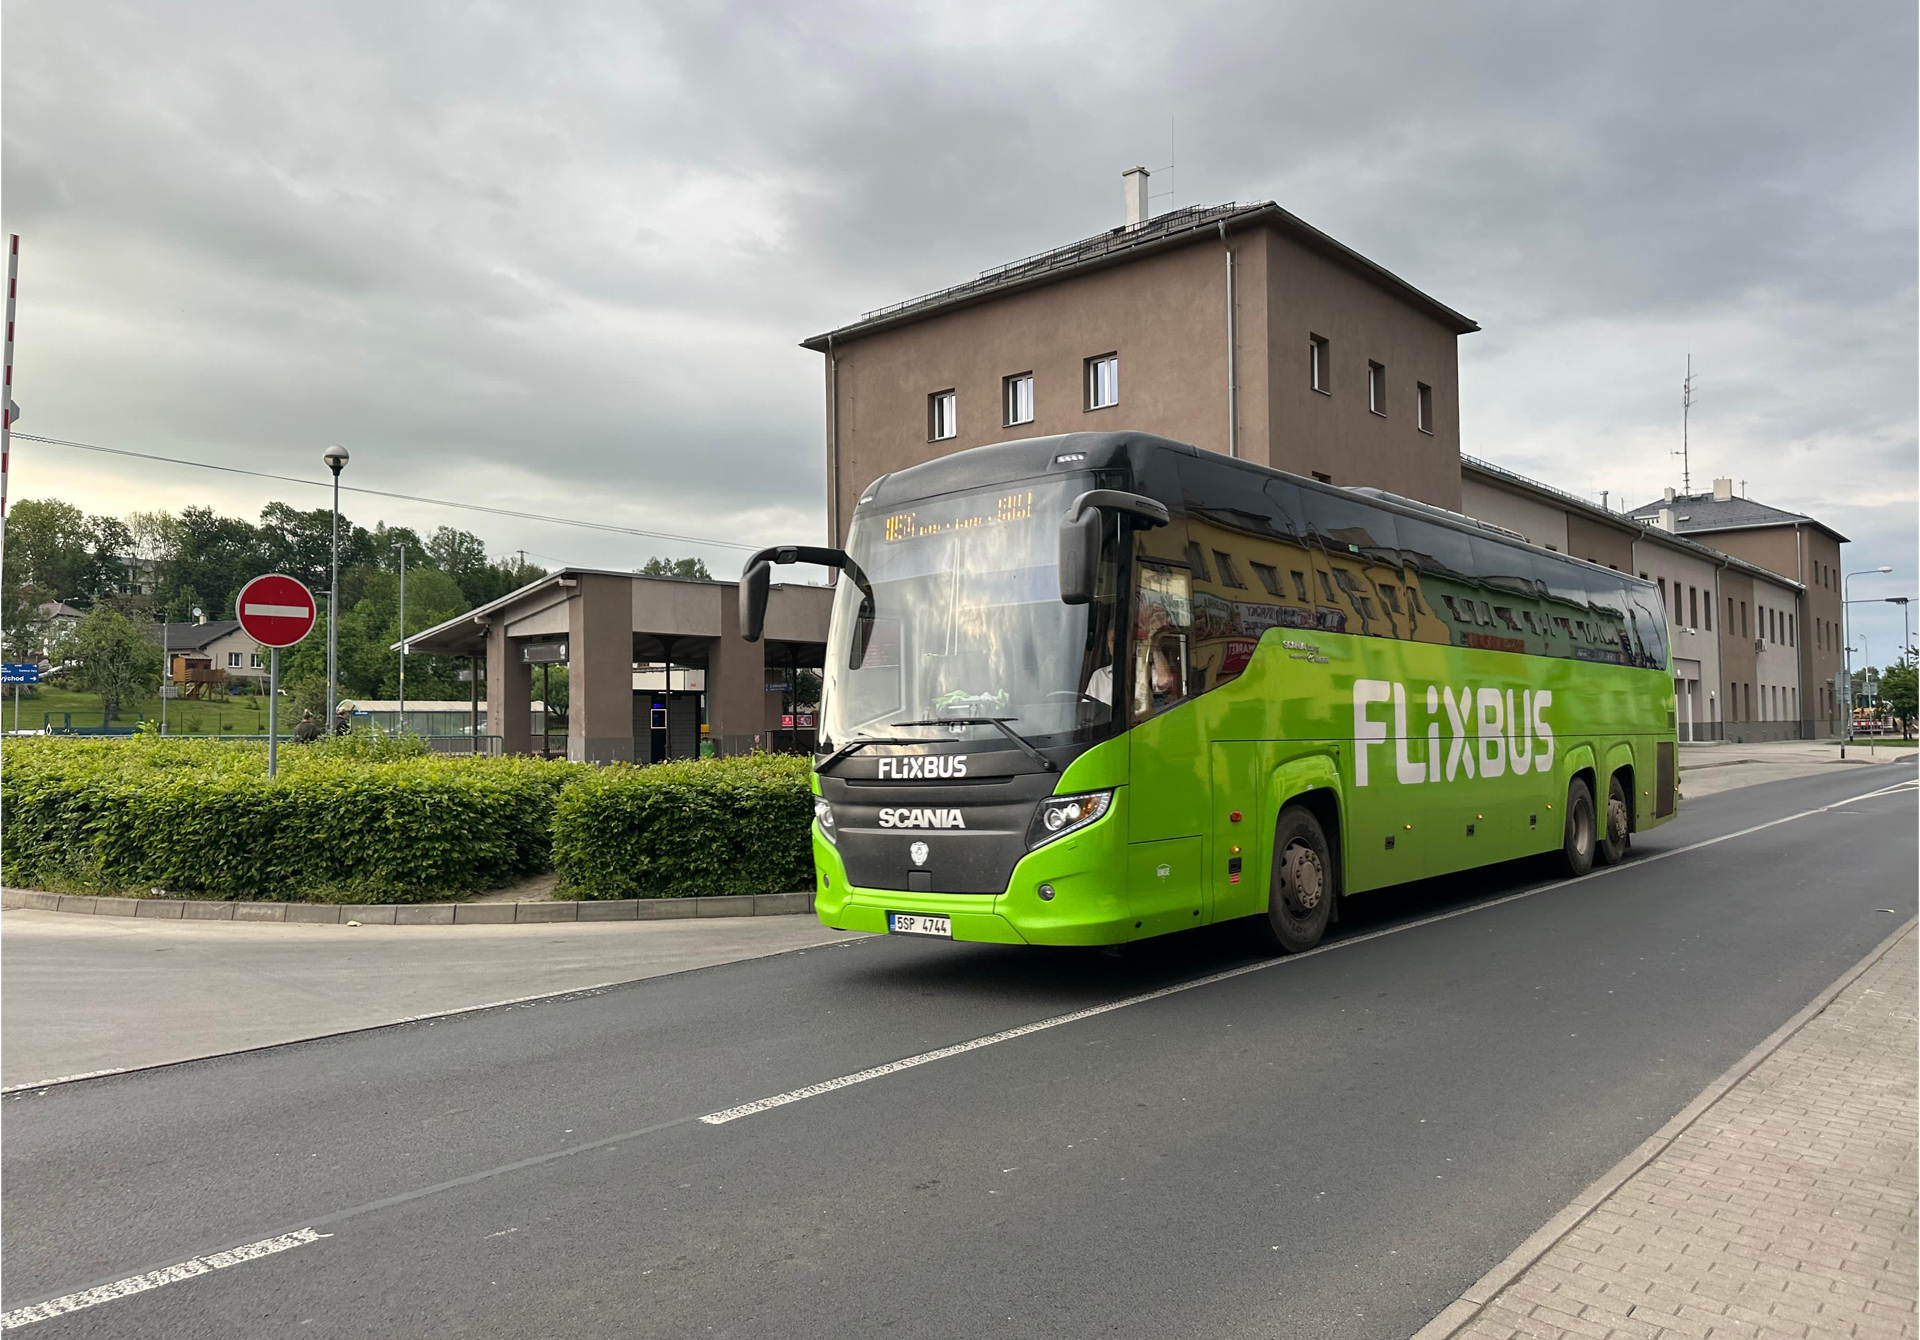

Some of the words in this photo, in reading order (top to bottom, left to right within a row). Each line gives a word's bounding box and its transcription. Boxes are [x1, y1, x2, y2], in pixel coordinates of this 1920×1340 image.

[1282, 640, 1306, 650] SCANIA
[879, 808, 966, 828] SCANIA
[897, 917, 915, 930] 5SP
[922, 919, 947, 933] 4744
